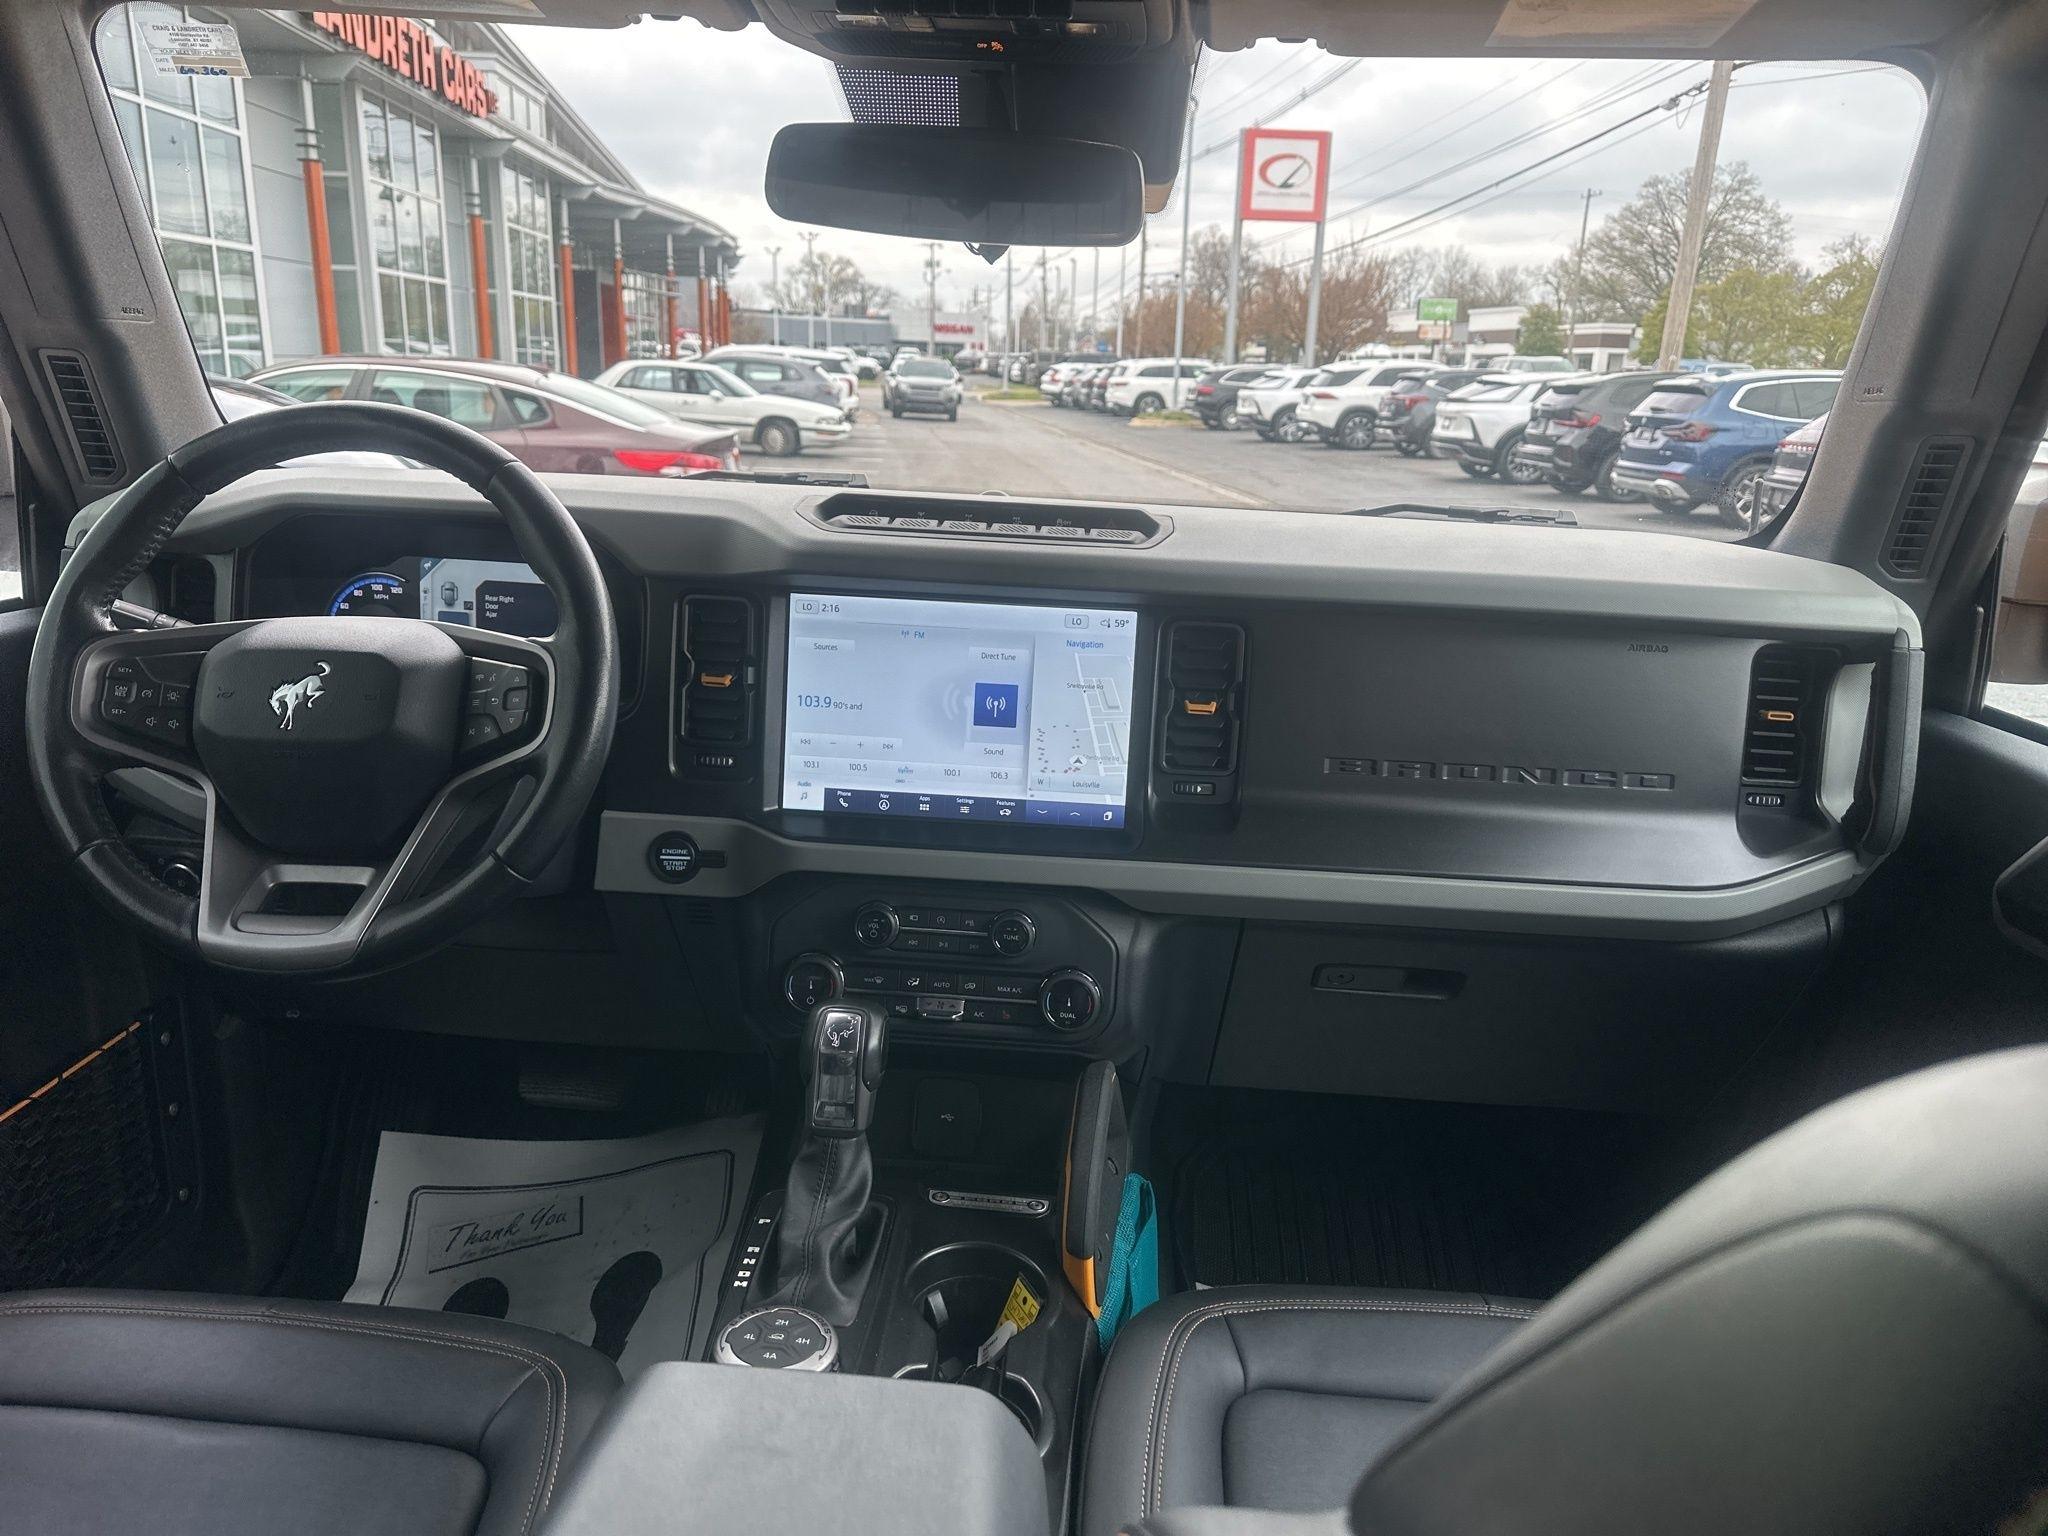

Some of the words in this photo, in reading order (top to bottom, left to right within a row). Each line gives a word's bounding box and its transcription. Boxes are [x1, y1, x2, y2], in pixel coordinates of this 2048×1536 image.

[313, 12, 437, 91] NDRETH
[441, 47, 488, 119] CARS
[370, 584, 383, 592] 100
[390, 586, 403, 594] 120
[500, 595, 514, 604] Right
[340, 602, 350, 610] 60
[802, 603, 813, 611] LO
[821, 604, 840, 612] 2:16
[1072, 618, 1082, 626] LO
[1114, 619, 1130, 628] 59°
[914, 631, 925, 639] FM
[814, 642, 838, 651] Sources
[1066, 639, 1104, 650] Navigation
[981, 652, 1000, 660] Direct
[1000, 652, 1016, 662] Tune
[798, 694, 832, 708] 103.9
[832, 702, 848, 710] 90's
[850, 702, 862, 710] and
[984, 748, 1004, 756] Sound
[803, 760, 820, 768] 103.1
[848, 763, 868, 772] 100.5
[944, 768, 961, 777] 100.1
[990, 771, 1009, 780] 106.3
[1324, 757, 1675, 791] BRONCO
[1072, 780, 1100, 789] Louisville
[446, 1212, 525, 1252] Thank
[530, 1204, 568, 1231] You
